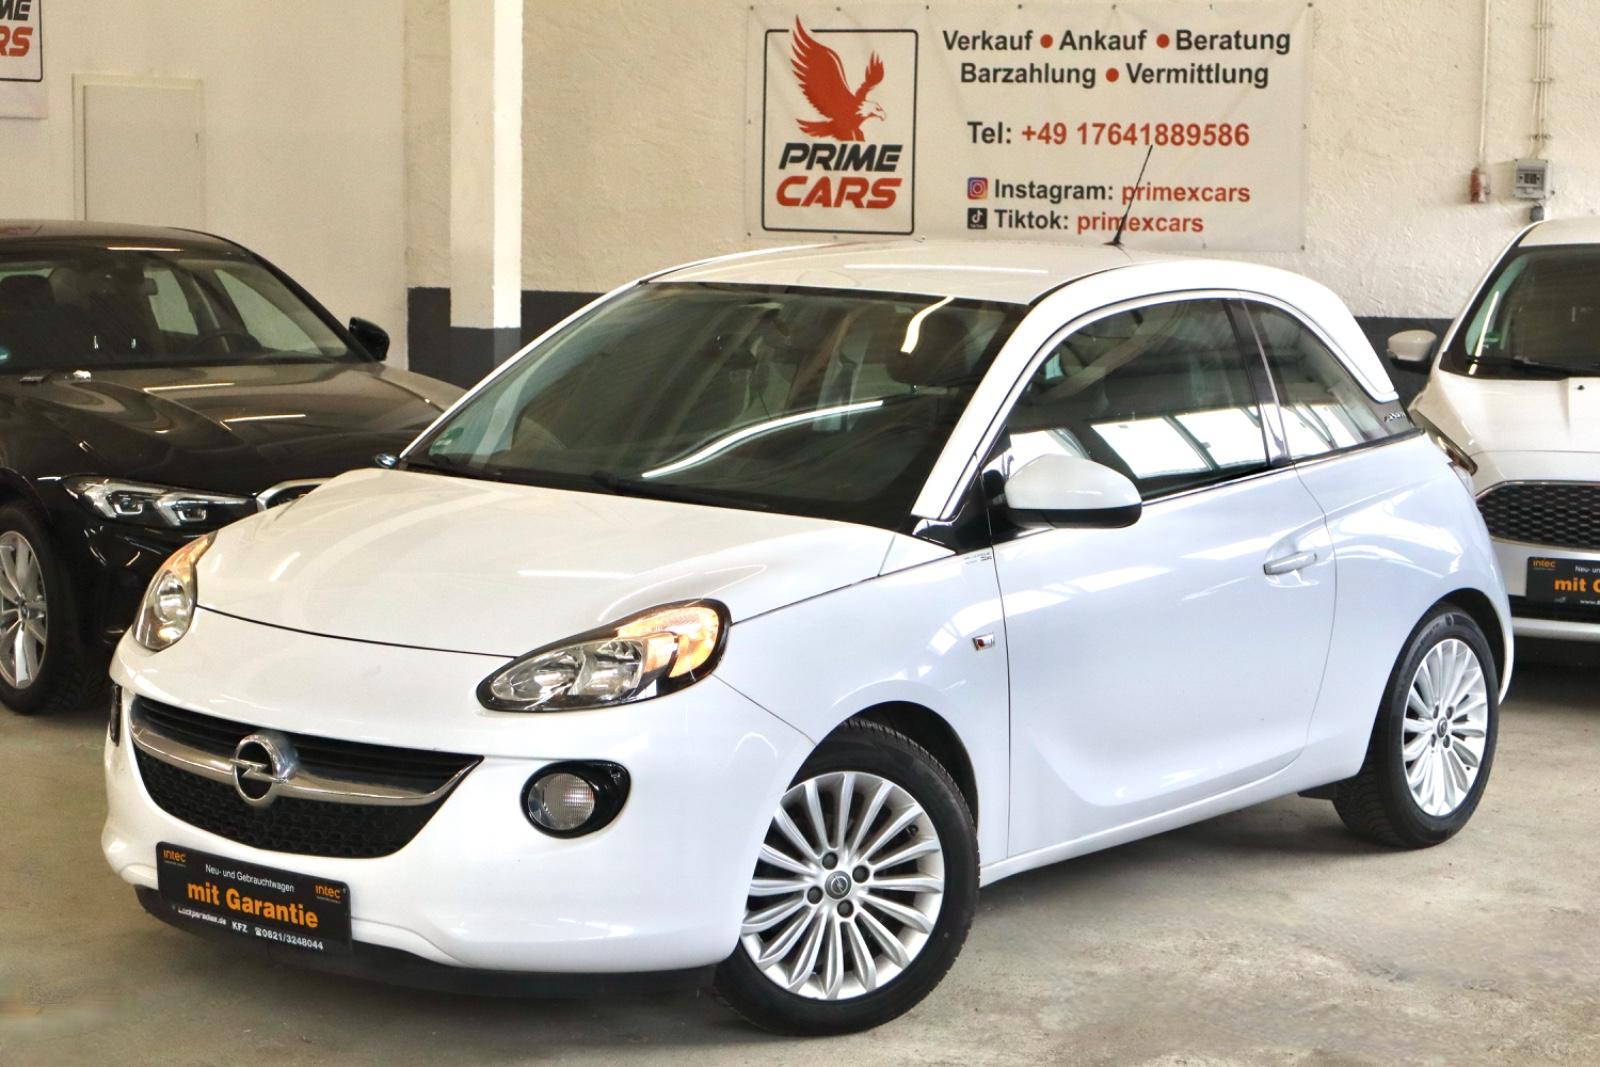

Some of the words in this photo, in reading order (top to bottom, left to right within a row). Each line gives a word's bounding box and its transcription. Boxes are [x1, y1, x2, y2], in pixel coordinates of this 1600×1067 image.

[943, 29, 1033, 51] Verkauf
[1060, 29, 1148, 51] Ankauf
[1176, 29, 1290, 55] Beratung
[961, 62, 1096, 89] Barzahlung
[1126, 62, 1269, 89] Vermittlung
[967, 121, 1012, 144] Tel:
[1022, 122, 1067, 146] +49
[1079, 122, 1250, 147] 17641889586
[778, 142, 903, 172] PRIME
[776, 175, 903, 209] CARS
[995, 179, 1114, 205] Instagram:
[1121, 183, 1250, 206] primexcars
[995, 209, 1069, 230] Tiktok:
[1076, 211, 1204, 235] primexcars
[1554, 578, 1587, 592] mit
[205, 863, 222, 876] Neu-
[222, 866, 236, 879] und
[236, 871, 295, 893] Gebrauchtwagen
[187, 881, 220, 907] mit
[225, 886, 320, 929] Garantie
[315, 884, 341, 900] intec
[232, 920, 250, 934] KFZ
